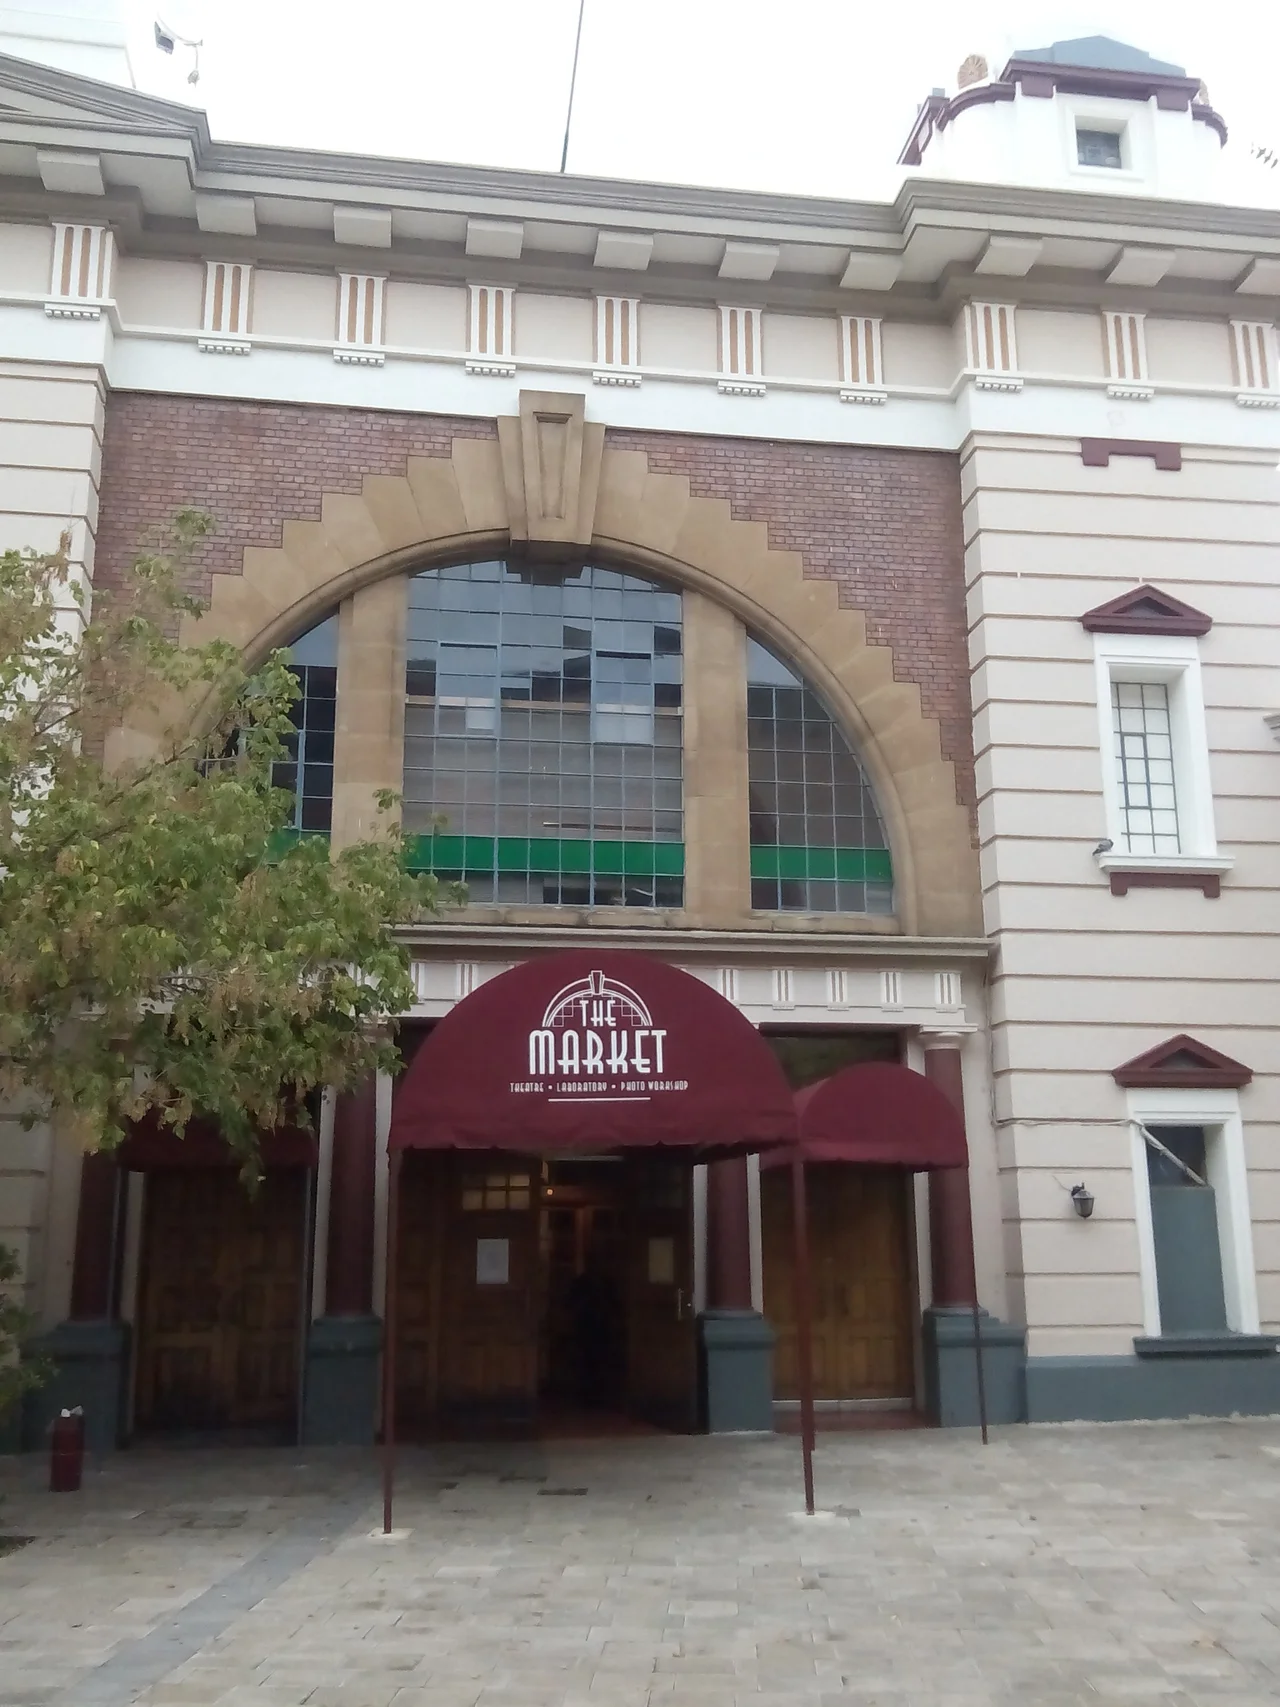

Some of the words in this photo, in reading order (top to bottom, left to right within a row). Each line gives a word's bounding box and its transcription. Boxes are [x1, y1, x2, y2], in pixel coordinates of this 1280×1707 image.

[579, 1000, 617, 1027] THE
[529, 1029, 667, 1075] MARKET
[510, 1082, 544, 1093] THEATRE
[557, 1082, 608, 1092] LABORATORY
[620, 1081, 646, 1091] PHOTO
